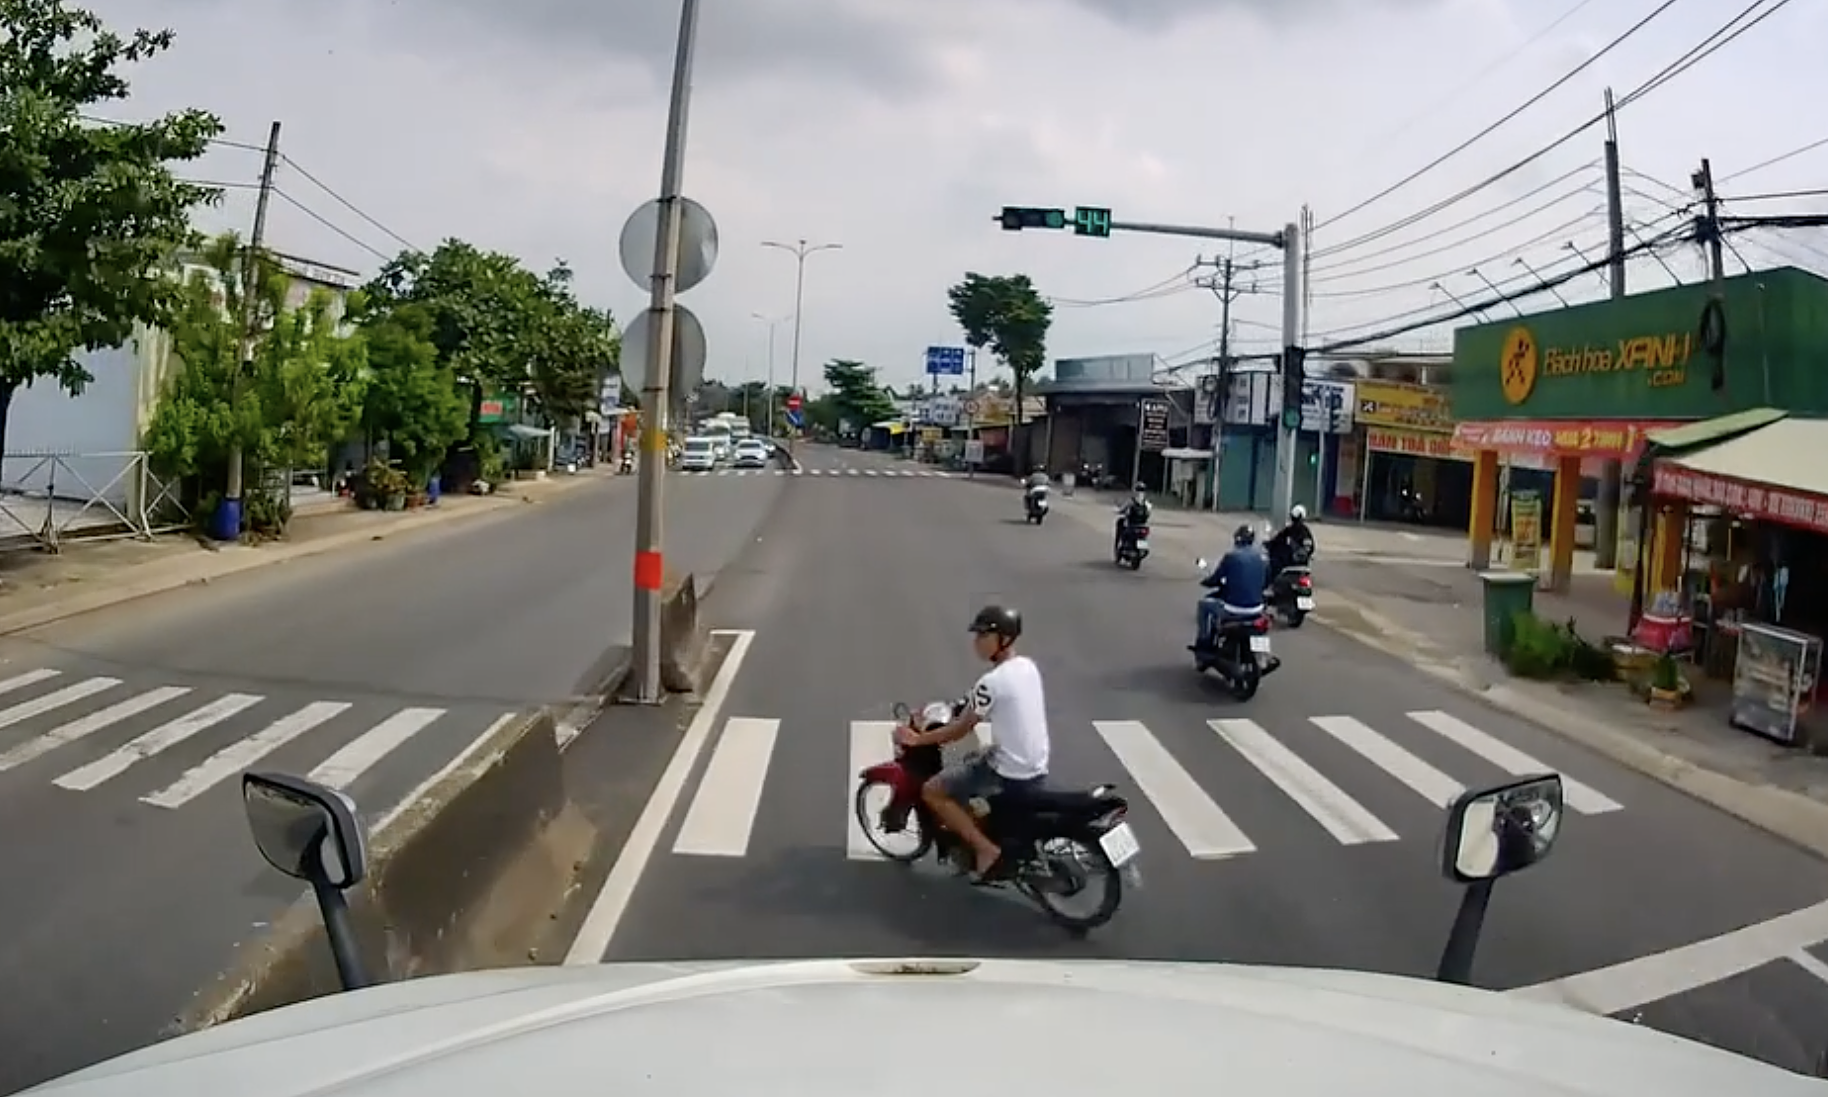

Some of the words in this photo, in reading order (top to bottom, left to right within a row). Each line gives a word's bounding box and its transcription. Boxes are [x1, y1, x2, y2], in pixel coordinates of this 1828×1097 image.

[1077, 209, 1109, 235] 44
[1614, 331, 1690, 370] XANH
[1578, 426, 1592, 449] 2
